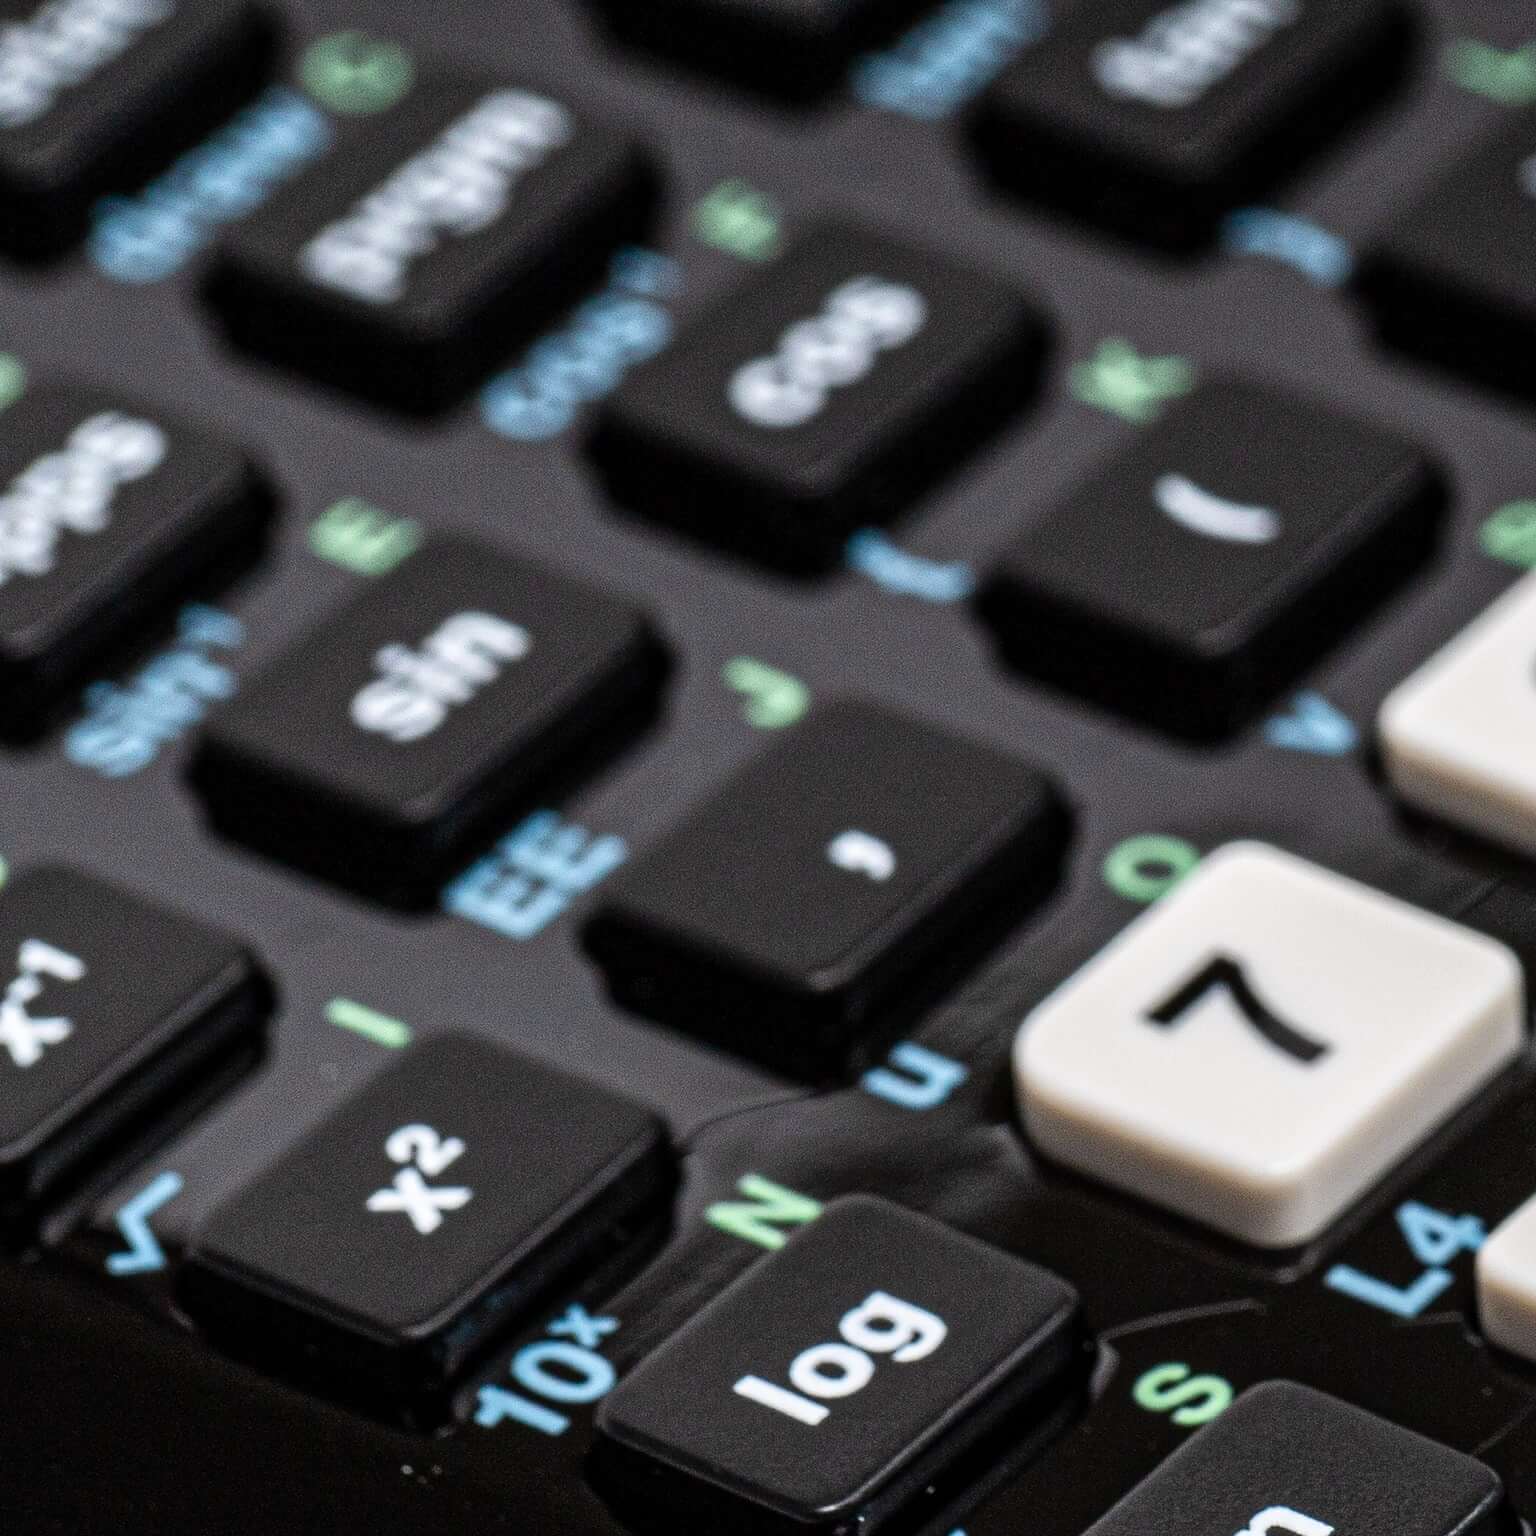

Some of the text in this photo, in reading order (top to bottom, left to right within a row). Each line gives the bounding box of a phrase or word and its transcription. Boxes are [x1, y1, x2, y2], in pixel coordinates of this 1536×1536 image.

[733, 284, 920, 424] cos
[1160, 479, 1272, 541] (
[353, 615, 525, 739] sin
[444, 810, 623, 937] EE
[832, 834, 893, 877] ,
[1146, 954, 1328, 1064] 7
[864, 1042, 965, 1110] u
[708, 1179, 822, 1251] N
[1327, 1201, 1488, 1317] L4
[734, 1293, 946, 1425] log
[1135, 1365, 1233, 1427] S
